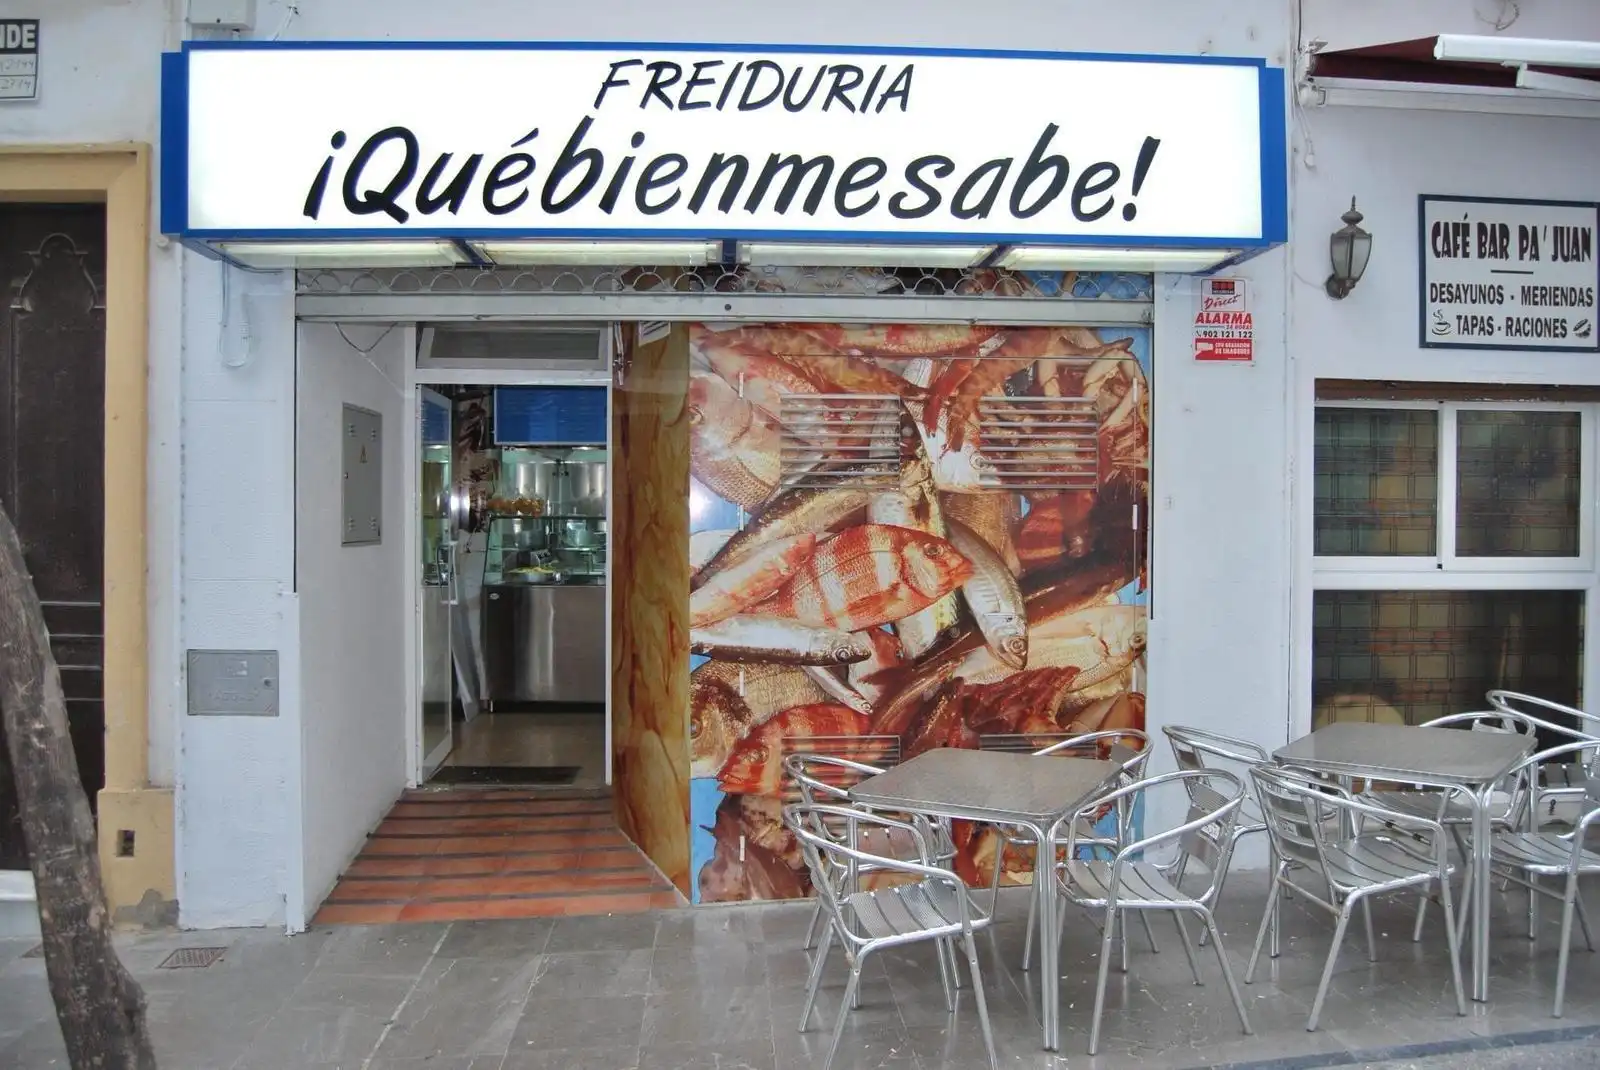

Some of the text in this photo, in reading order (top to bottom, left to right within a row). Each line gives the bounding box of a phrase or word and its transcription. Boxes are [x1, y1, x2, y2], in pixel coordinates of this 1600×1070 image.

[594, 59, 914, 114] FREIDURIA
[303, 115, 1161, 224] ¡Québienmesabe!
[1431, 212, 1471, 259] CAFÉ
[1476, 221, 1510, 261] BAR
[1551, 225, 1592, 263] JUAN
[1430, 282, 1594, 308] DESAYUNOS MERIENDAS
[1195, 312, 1252, 324] ALARMA
[1456, 314, 1568, 339] TAPAS RACIONES
[1202, 330, 1253, 338] 902 121 122
